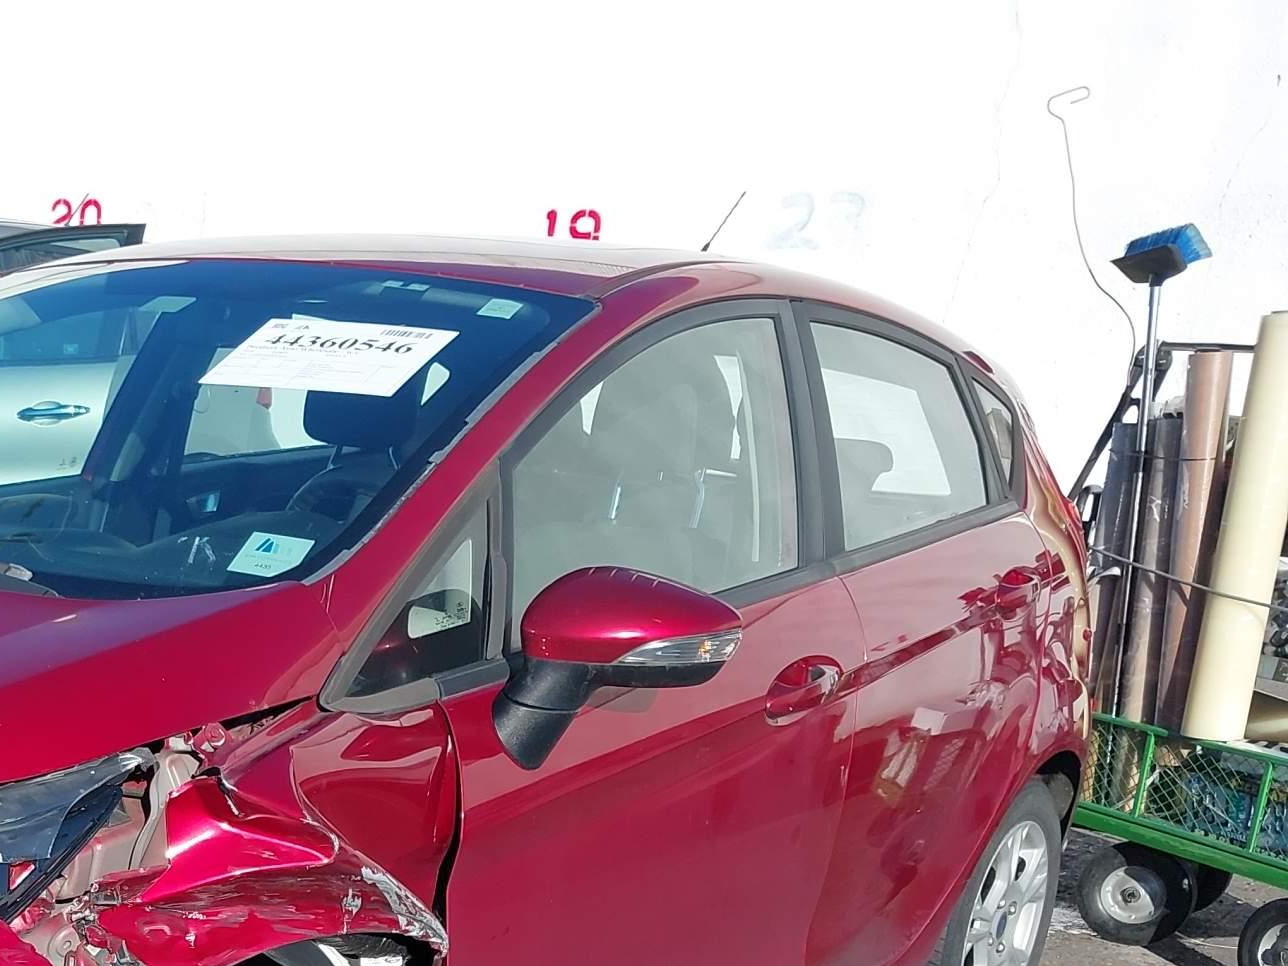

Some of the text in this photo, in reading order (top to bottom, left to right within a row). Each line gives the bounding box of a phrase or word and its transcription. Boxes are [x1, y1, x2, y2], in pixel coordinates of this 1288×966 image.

[51, 198, 104, 225] 20
[545, 208, 602, 241] 19
[265, 333, 417, 354] 44360546
